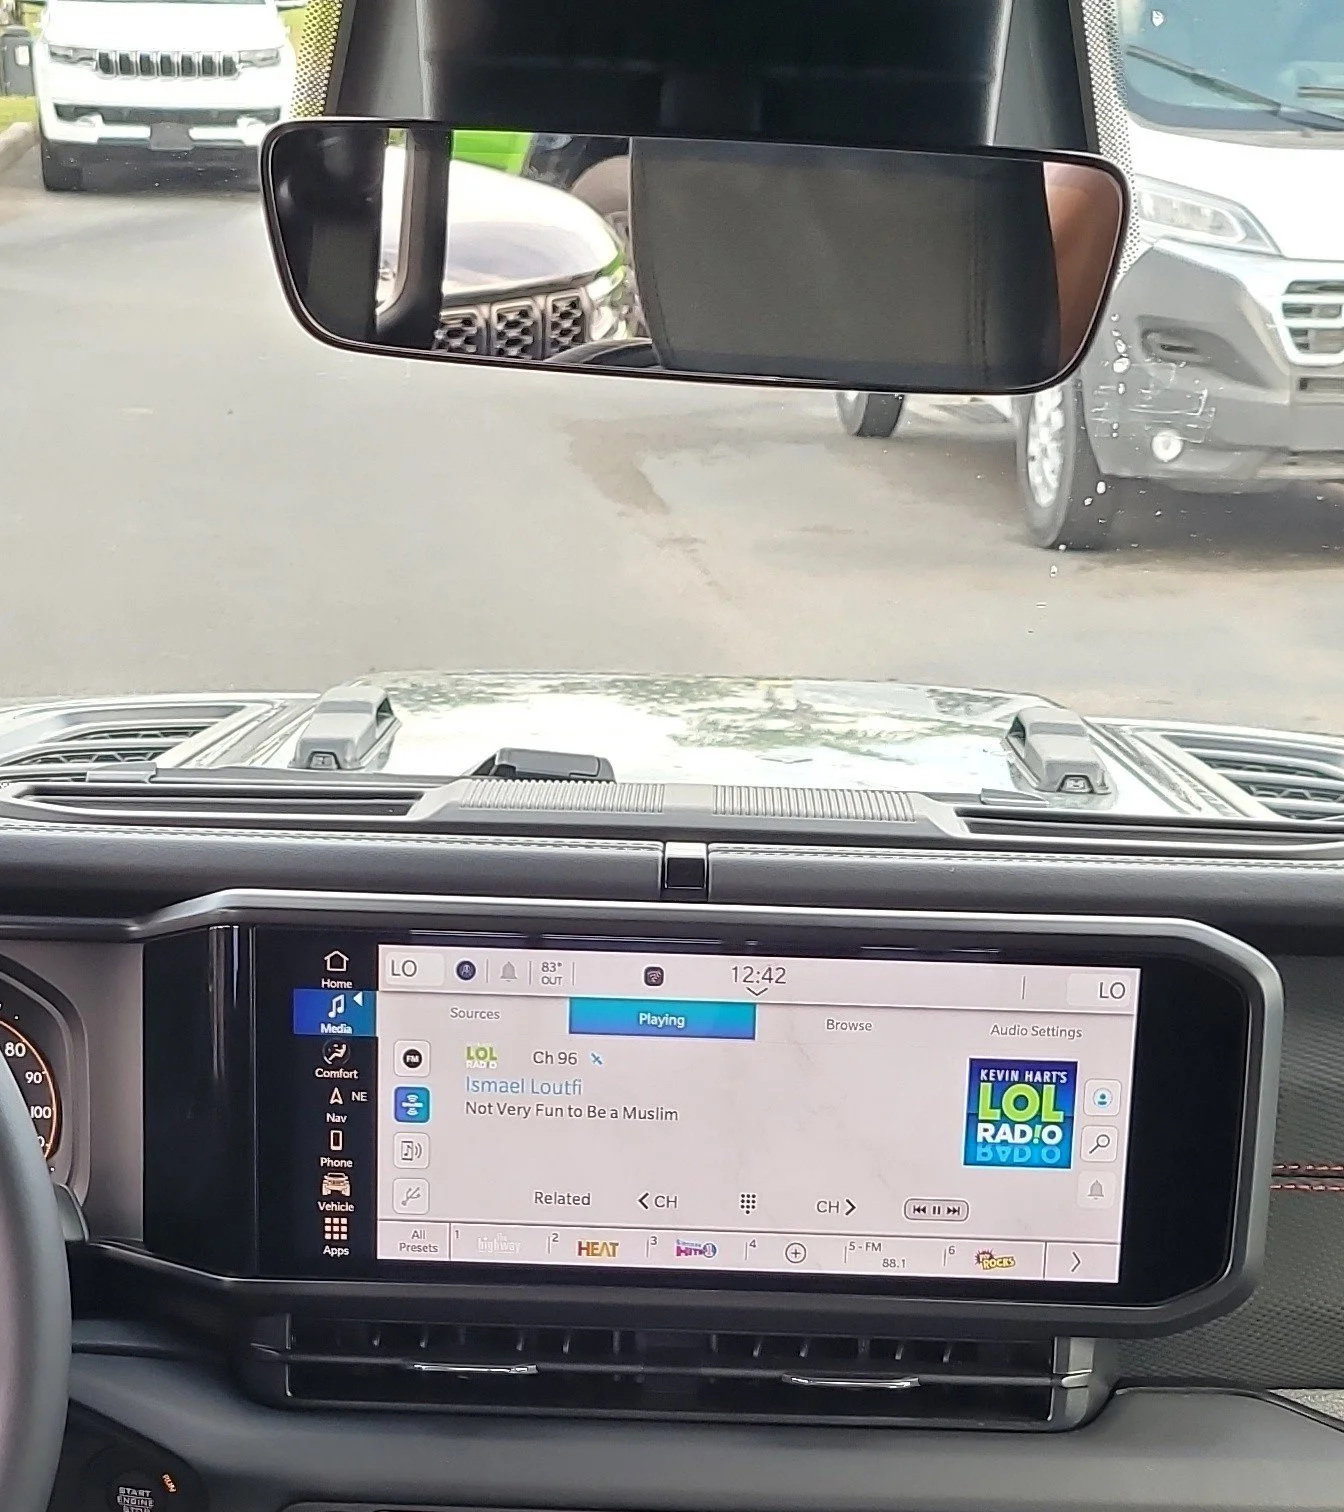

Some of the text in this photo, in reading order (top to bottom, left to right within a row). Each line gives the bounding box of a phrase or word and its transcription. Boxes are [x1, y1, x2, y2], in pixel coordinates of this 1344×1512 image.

[391, 961, 417, 977] LO
[731, 966, 787, 984] 12:42
[321, 979, 352, 989] Home
[541, 975, 563, 986] OUT
[1099, 982, 1126, 999] LO
[450, 1007, 500, 1020] Sources
[639, 1012, 685, 1028] Playing
[826, 1019, 873, 1032] Browse
[320, 1023, 352, 1034] Media
[991, 1024, 1082, 1040] Audio Settings
[5, 1042, 26, 1058] 80
[466, 1047, 497, 1060] LOL
[533, 1052, 577, 1066] Ch 96
[25, 1072, 42, 1083] 90
[315, 1068, 358, 1079] Comfort
[980, 1069, 1067, 1083] KEVIN HART'S
[466, 1077, 582, 1096] Ismael Loutfi
[352, 1091, 368, 1102] NE
[978, 1082, 1064, 1122] LOL
[31, 1106, 51, 1119] 100
[466, 1102, 679, 1121] Not Very Fun to Be a Muslim
[327, 1113, 347, 1123] Nav
[320, 1157, 352, 1168] Phone
[534, 1192, 591, 1206] Related
[655, 1196, 678, 1209] CH
[318, 1202, 354, 1212] Vehicle
[817, 1200, 840, 1214] CH
[411, 1229, 426, 1239] All
[552, 1233, 559, 1242] 2
[651, 1236, 658, 1245] 3
[749, 1240, 756, 1249] 4
[323, 1245, 350, 1257] Apps
[399, 1242, 438, 1253] Presets
[578, 1241, 619, 1257] HEAT
[865, 1243, 882, 1252] FM
[948, 1246, 955, 1256] 6
[882, 1258, 906, 1268] 88.1
[118, 1486, 152, 1497] START
[117, 1495, 154, 1507] ENGINE
